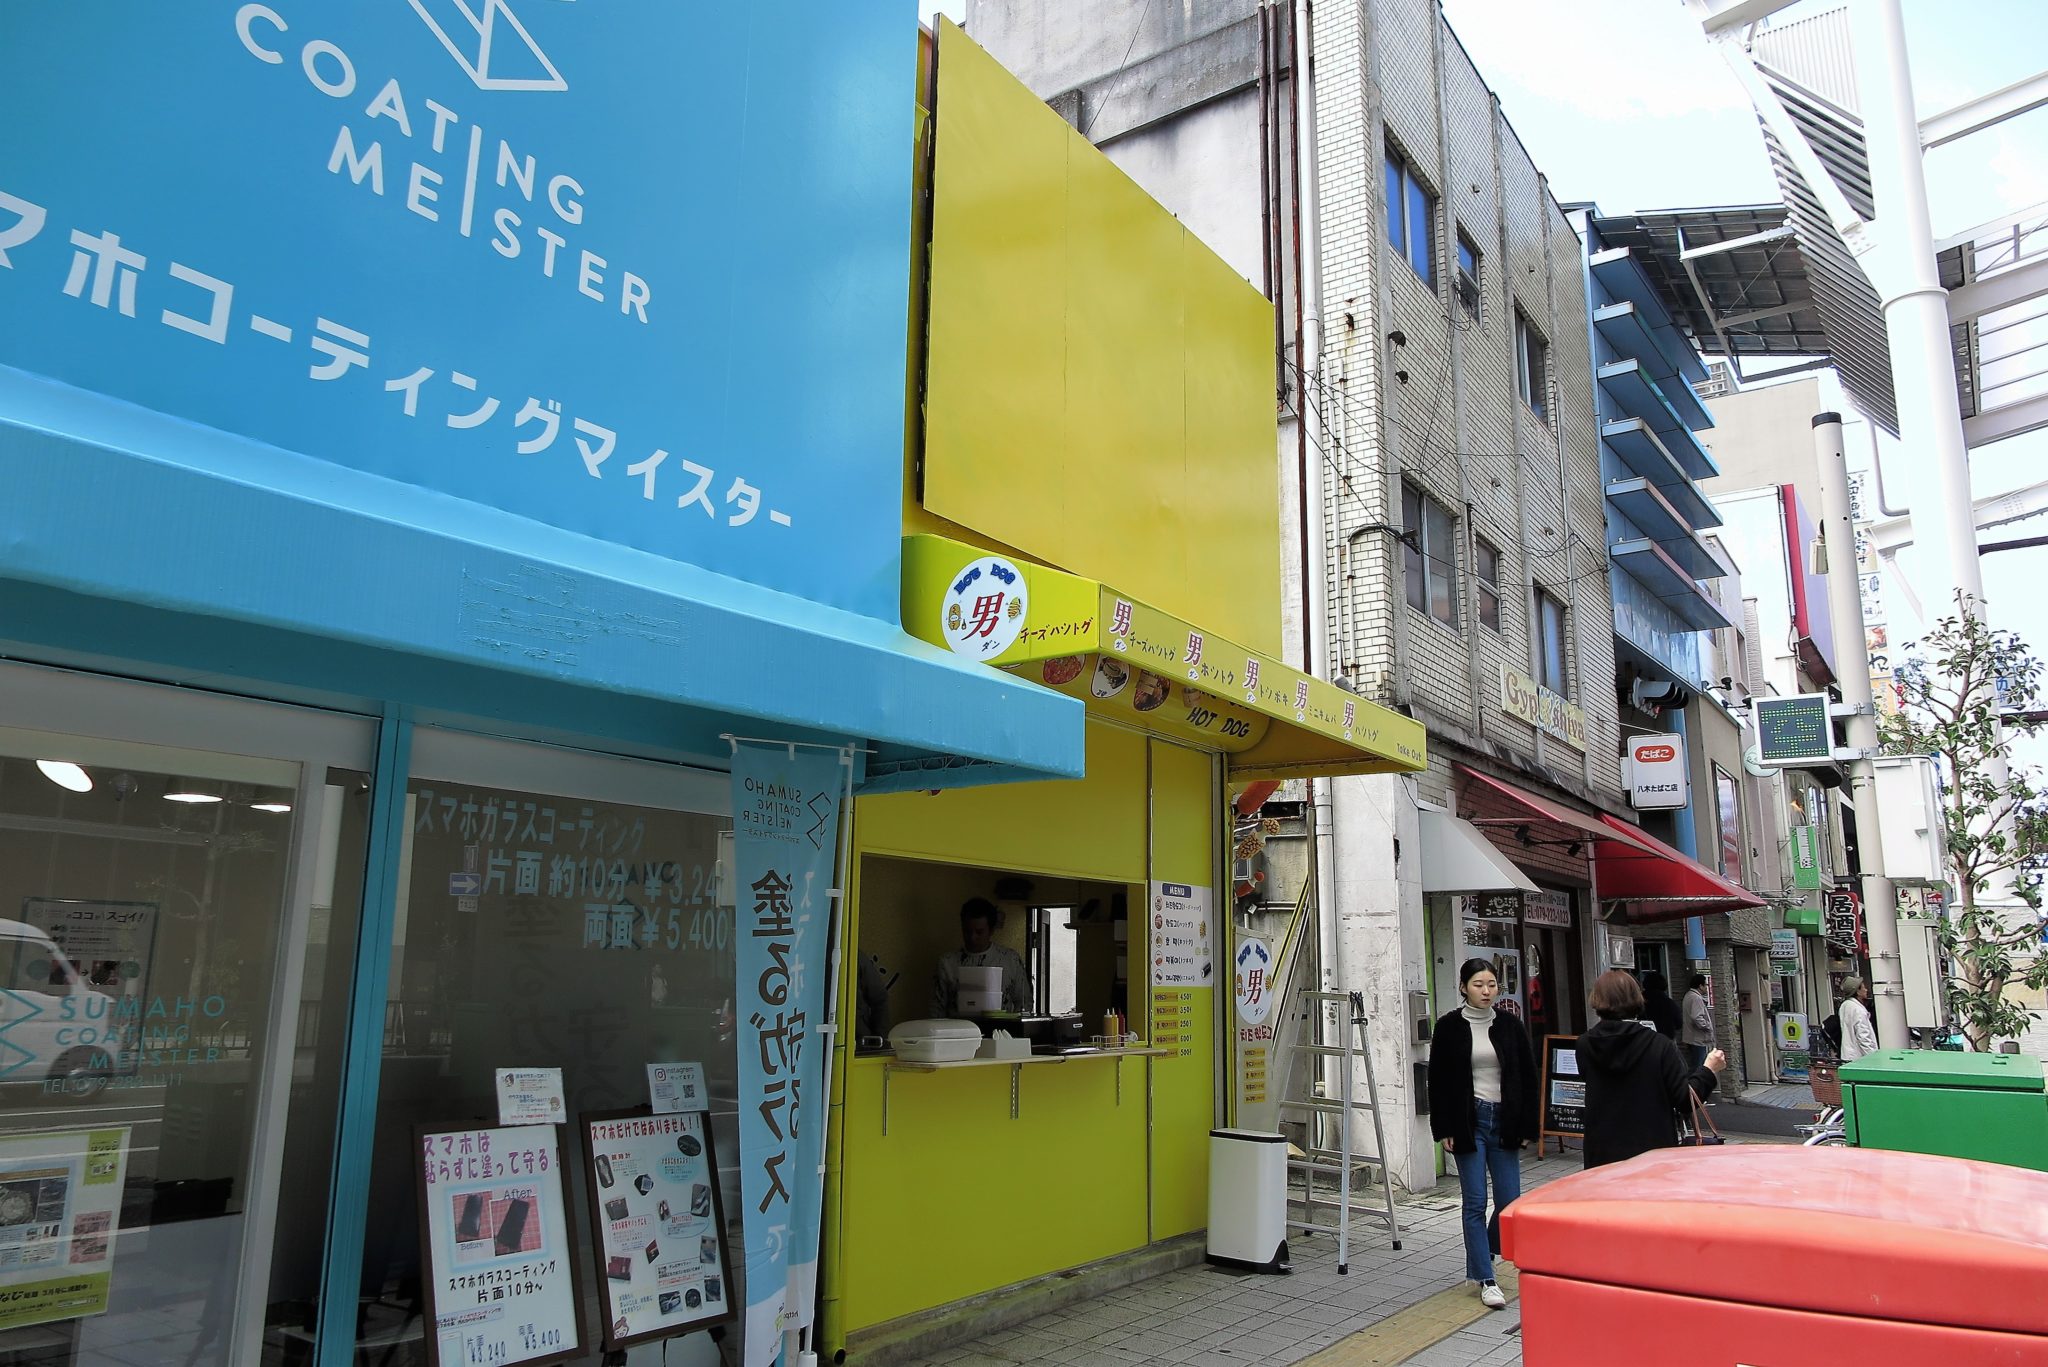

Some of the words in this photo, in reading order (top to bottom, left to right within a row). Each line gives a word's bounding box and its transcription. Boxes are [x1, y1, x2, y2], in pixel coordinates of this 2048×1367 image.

[235, 3, 586, 238] COATING
[327, 125, 652, 324] MEISTER
[961, 591, 1005, 642] 男
[1109, 599, 1133, 638] 男
[1183, 632, 1203, 666] 男
[1243, 659, 1260, 691] 男
[1295, 680, 1309, 711] 男
[1186, 706, 1218, 729] HOT
[1220, 717, 1250, 739] DOG
[1342, 701, 1356, 730] 男
[1411, 748, 1422, 762] Out
[1639, 748, 1672, 760] たばこ
[414, 789, 647, 853] スマホガラスコーティング
[1169, 886, 1185, 896] MENU
[1244, 967, 1264, 1006] 男
[59, 994, 226, 1021] SUMAHO
[55, 1024, 191, 1046] COATING
[88, 1048, 222, 1070] MEISTER
[423, 1131, 491, 1157] スマホは
[503, 1188, 533, 1200] After
[449, 1259, 557, 1292] スマホガラスコーティング
